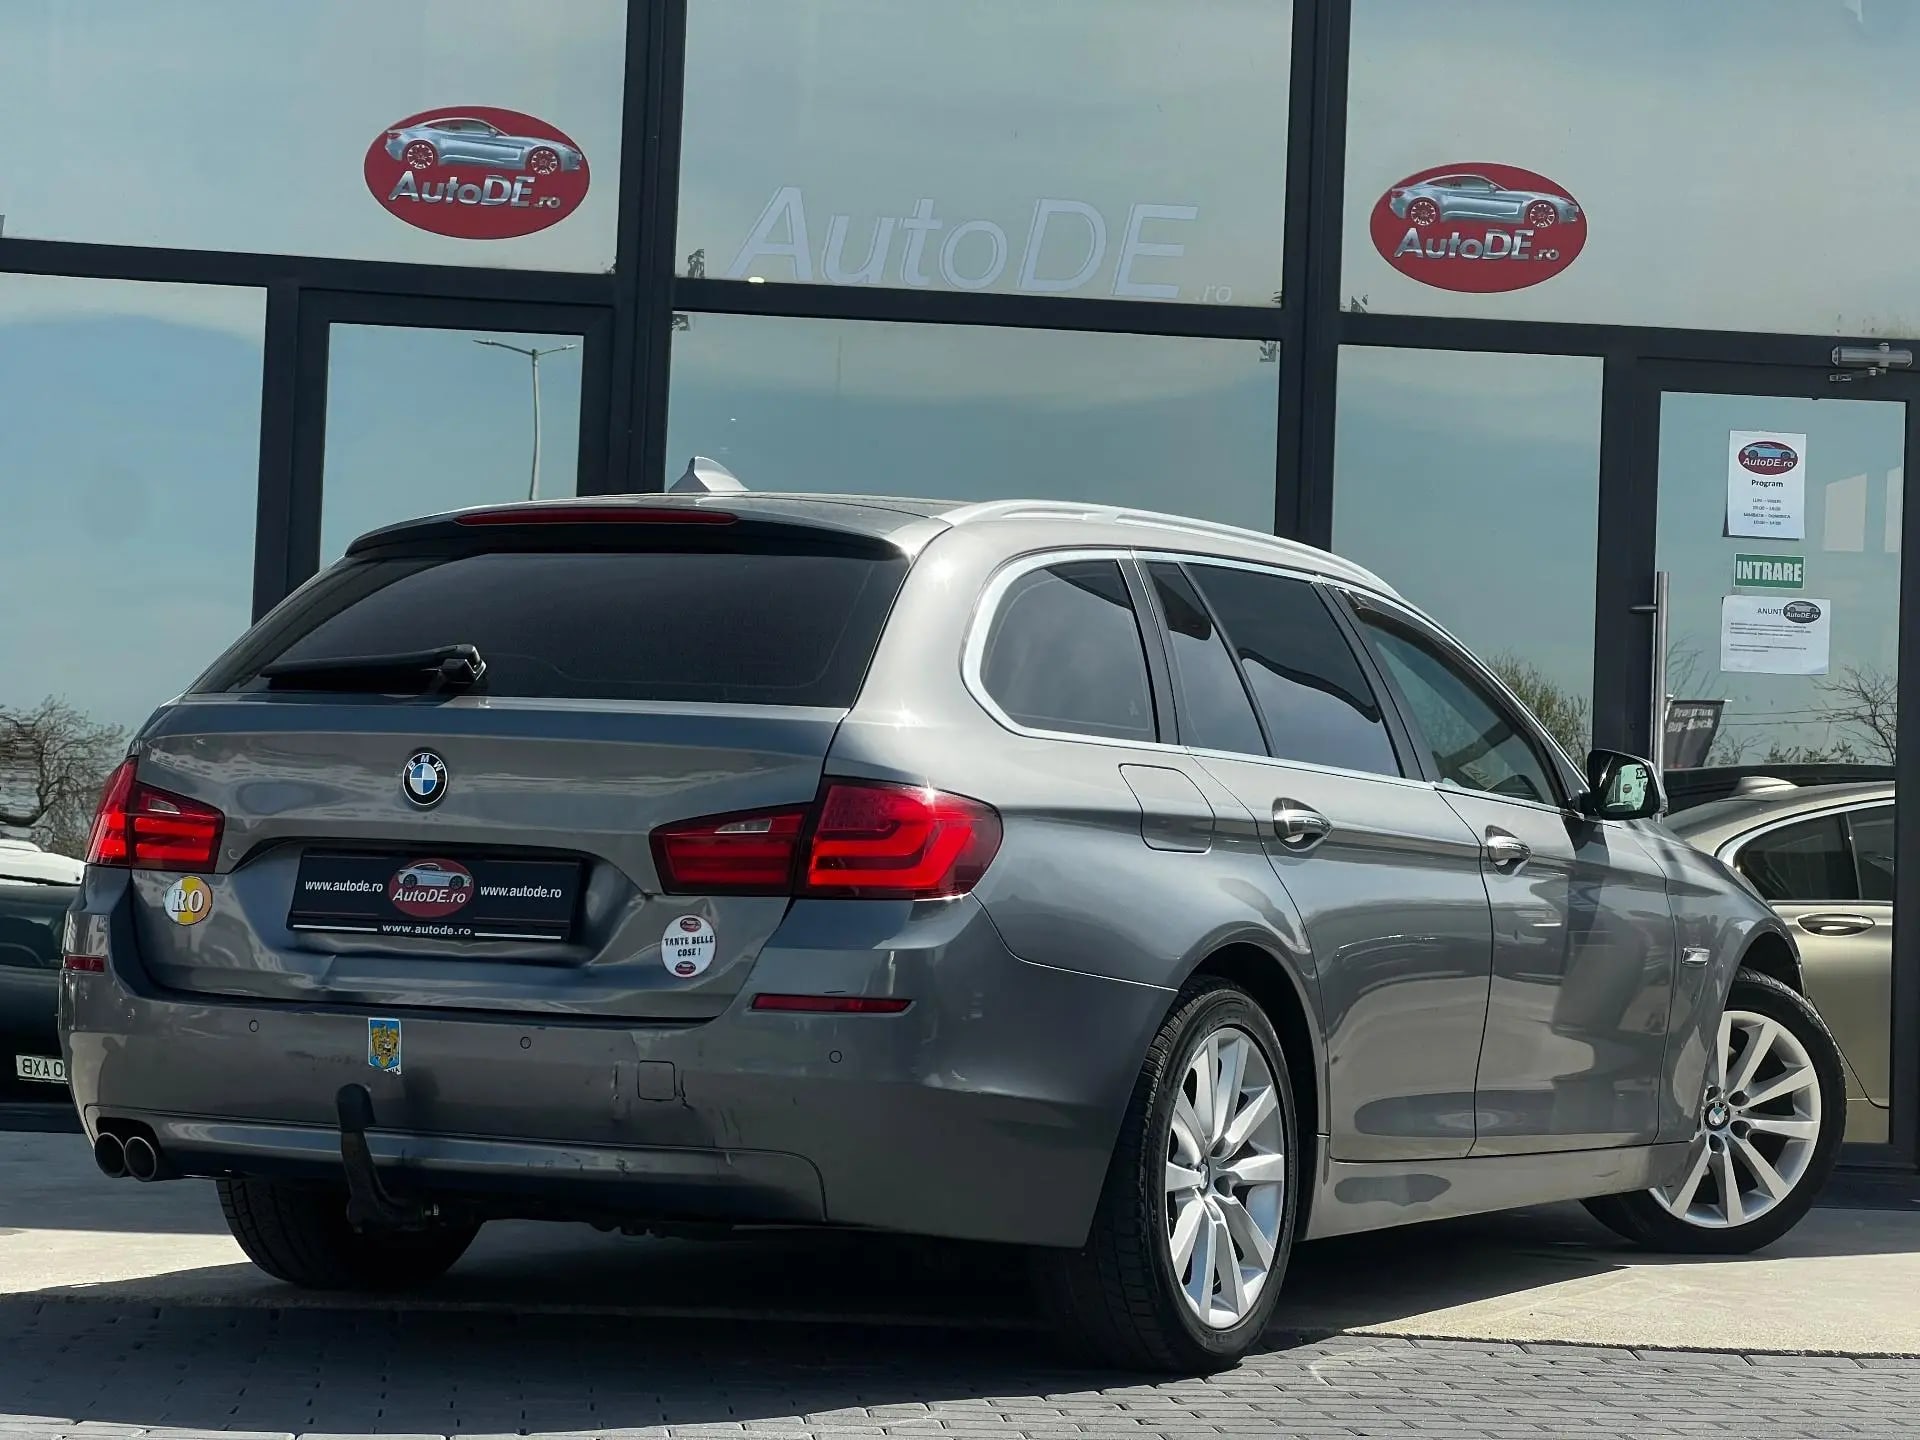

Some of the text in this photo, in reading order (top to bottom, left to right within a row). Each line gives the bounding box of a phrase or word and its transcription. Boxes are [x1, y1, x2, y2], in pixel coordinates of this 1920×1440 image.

[1742, 457, 1794, 468] AutoDE.ro
[1751, 479, 1784, 488] Program
[1736, 560, 1802, 581] INTRARE
[407, 754, 444, 772] BMW
[305, 879, 384, 893] www.autode.ro
[480, 884, 562, 899] www.autode.ro
[172, 888, 205, 913] RO
[392, 888, 467, 904] AutoDE.ro
[382, 922, 472, 936] www.autode.ro
[664, 935, 714, 947] TANTE BELLE
